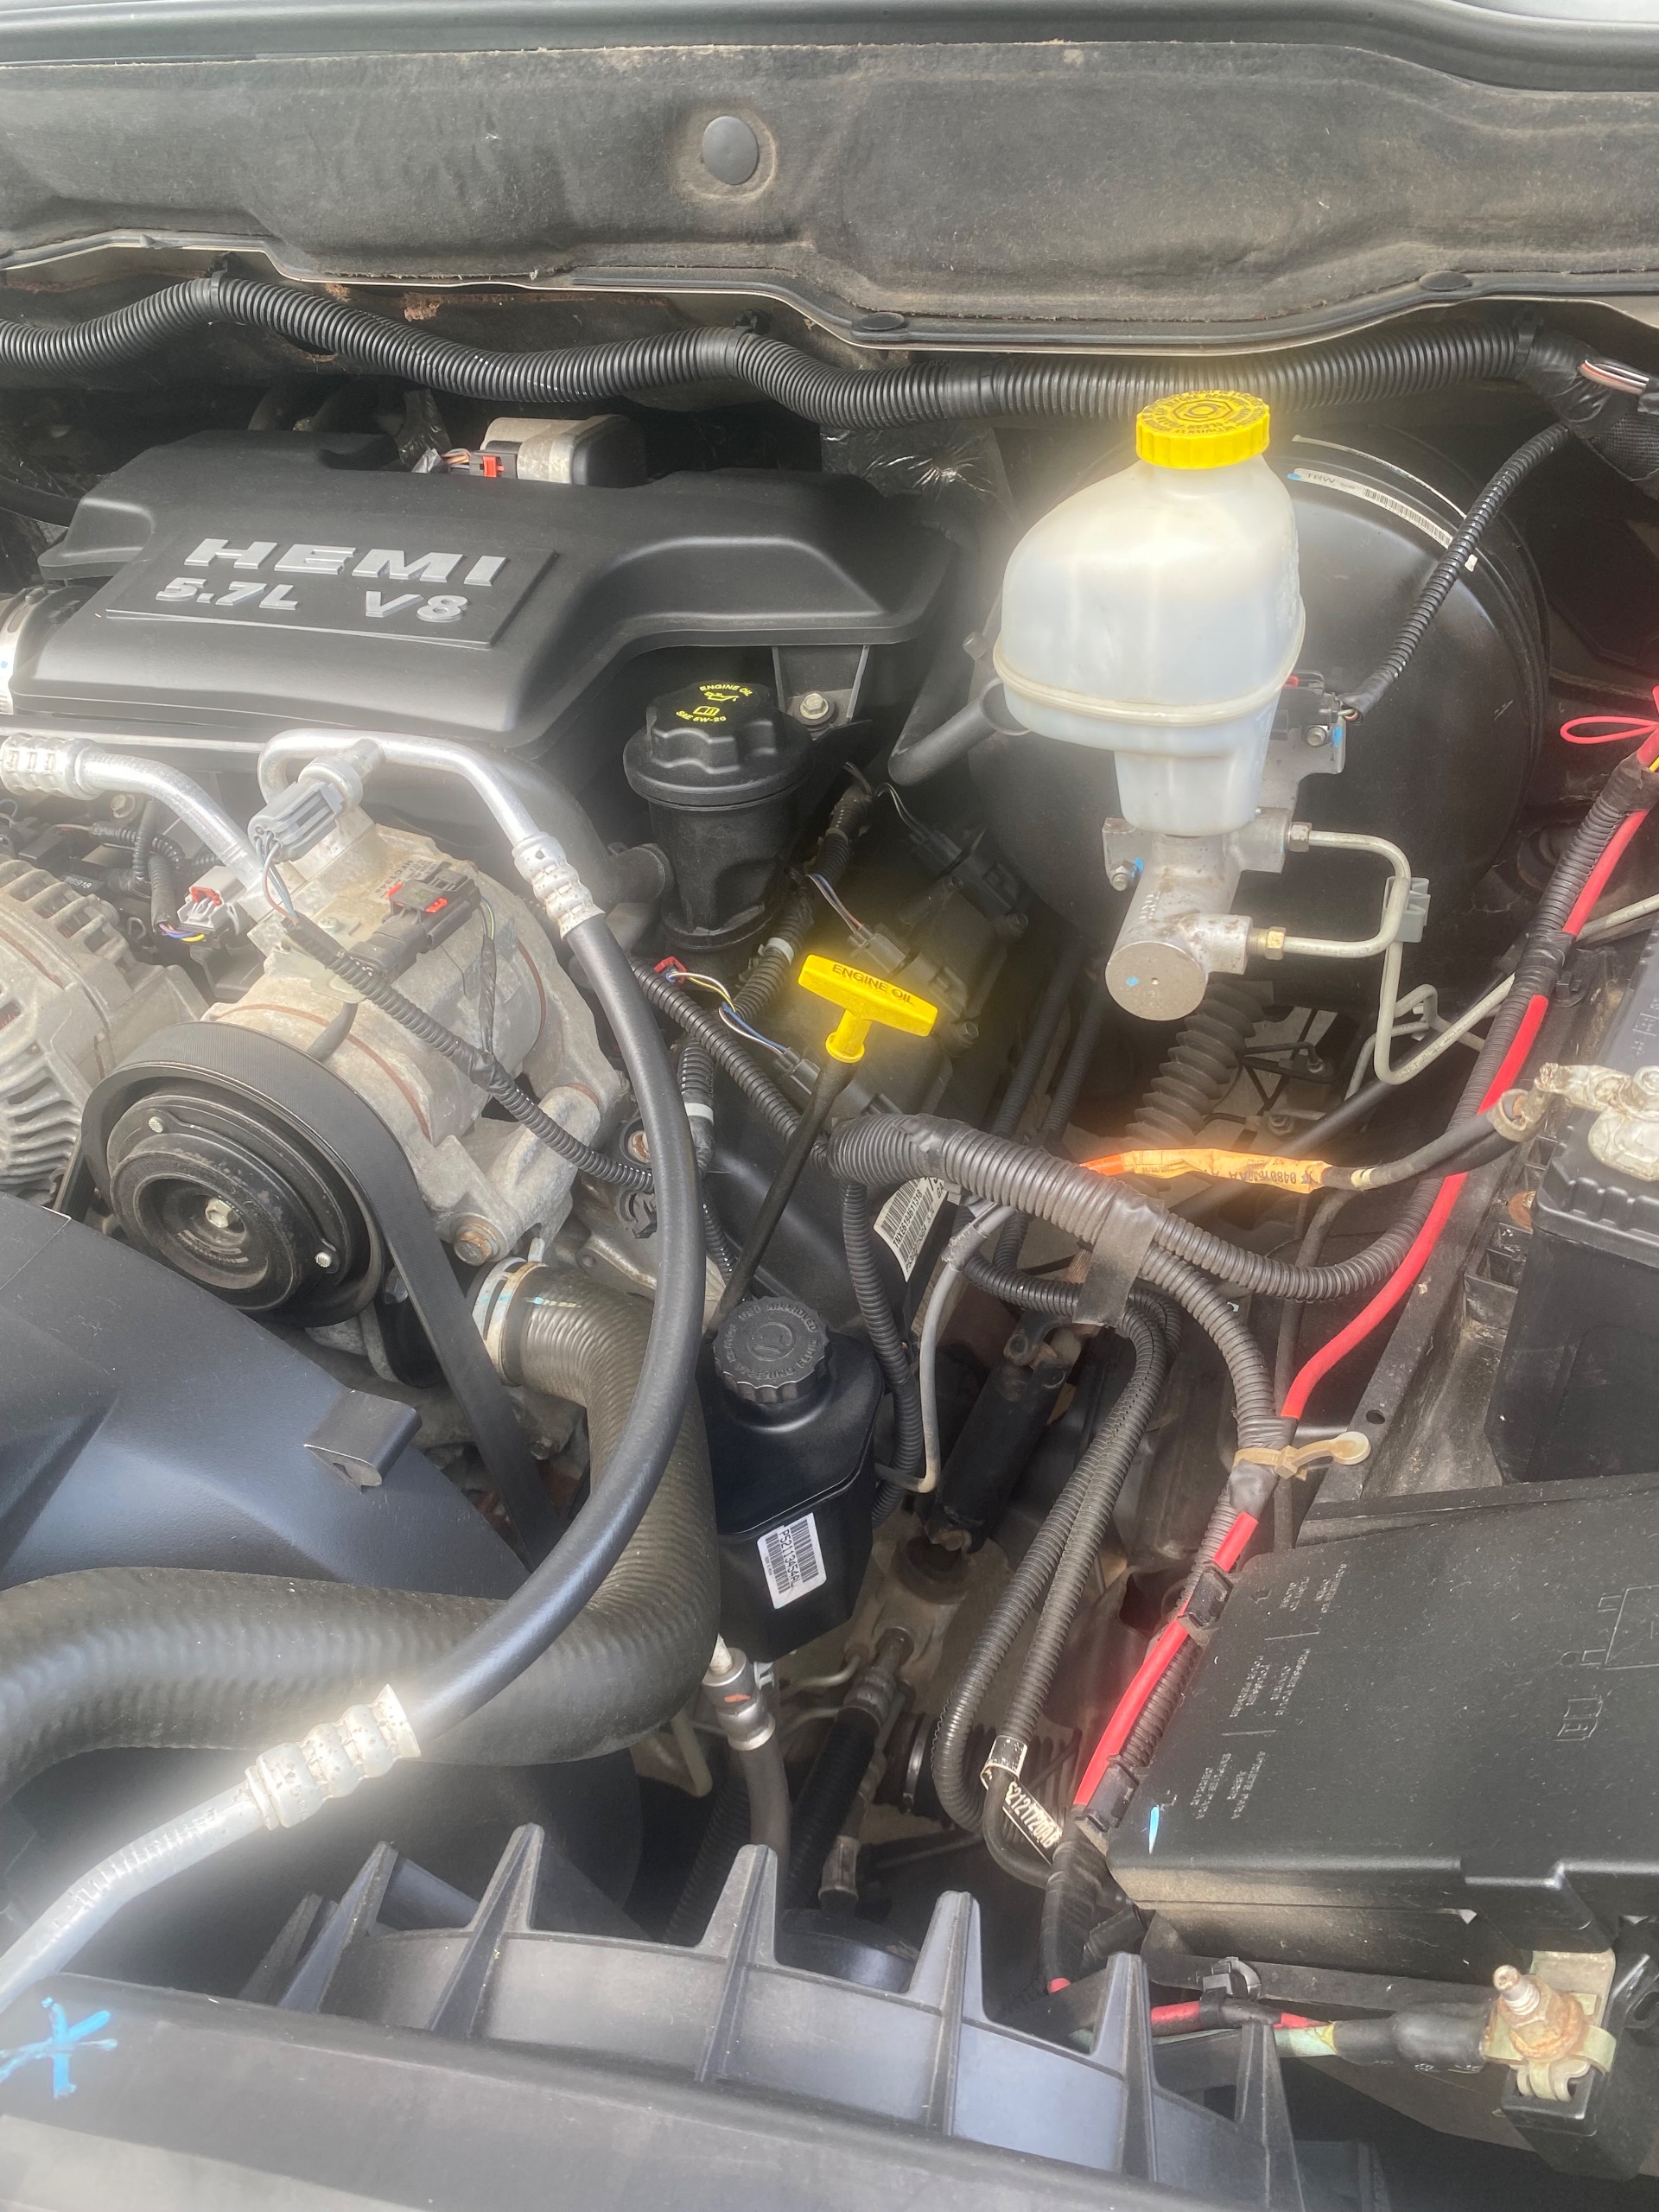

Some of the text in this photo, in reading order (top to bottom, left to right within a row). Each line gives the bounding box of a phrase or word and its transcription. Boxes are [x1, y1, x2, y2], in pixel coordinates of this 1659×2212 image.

[1307, 473, 1336, 484] TRW
[184, 537, 507, 587] HEMI
[156, 576, 468, 623] 5.7L V8
[739, 688, 753, 696] OIL
[676, 710, 693, 721] SAE
[832, 963, 914, 1007] ENGINE OIL
[739, 1302, 817, 1333] USE APPROVED
[796, 1339, 819, 1369] FLUID
